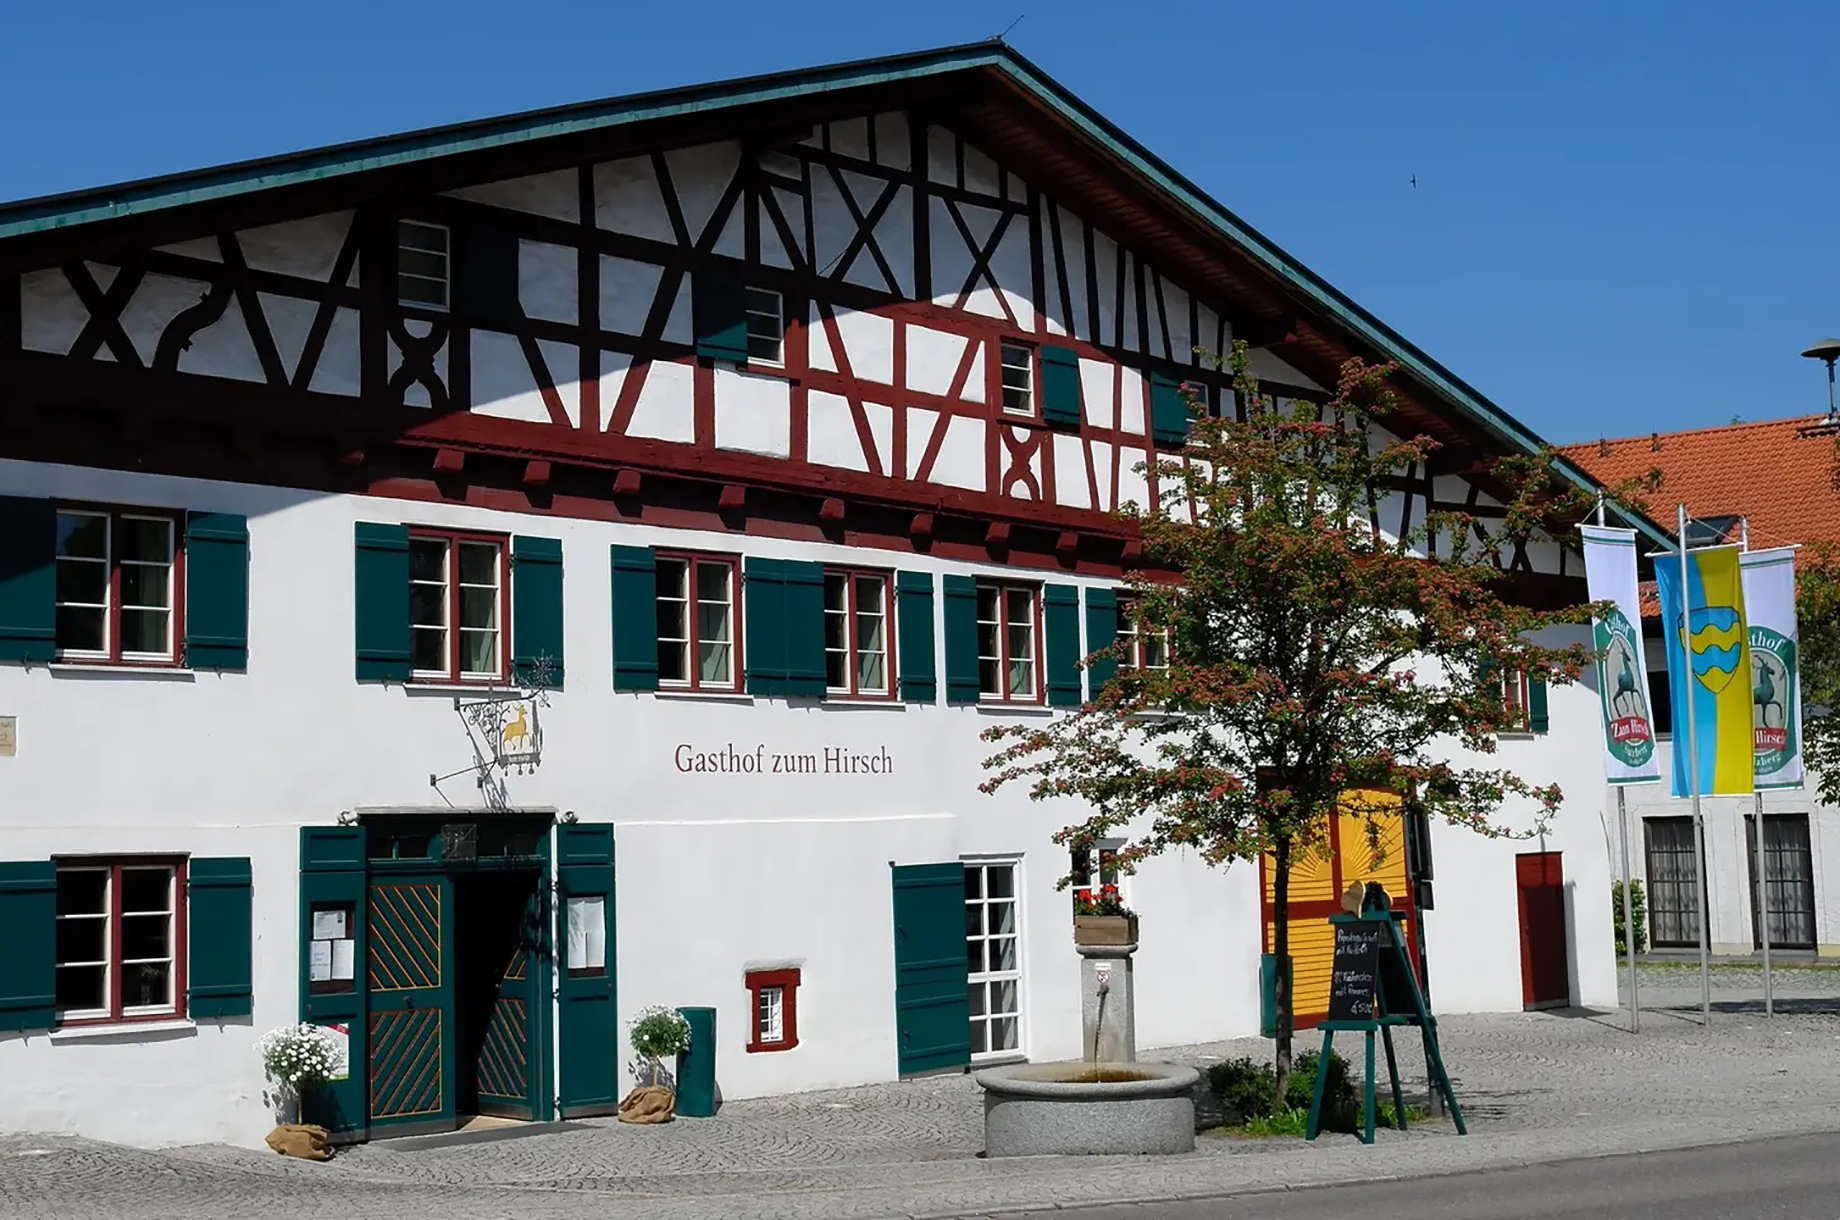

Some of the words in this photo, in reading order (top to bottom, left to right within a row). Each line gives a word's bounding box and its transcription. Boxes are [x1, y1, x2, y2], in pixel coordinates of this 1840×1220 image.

[674, 743, 764, 773] Gasthof
[771, 753, 817, 773] zum
[823, 746, 894, 774] Hirsch
